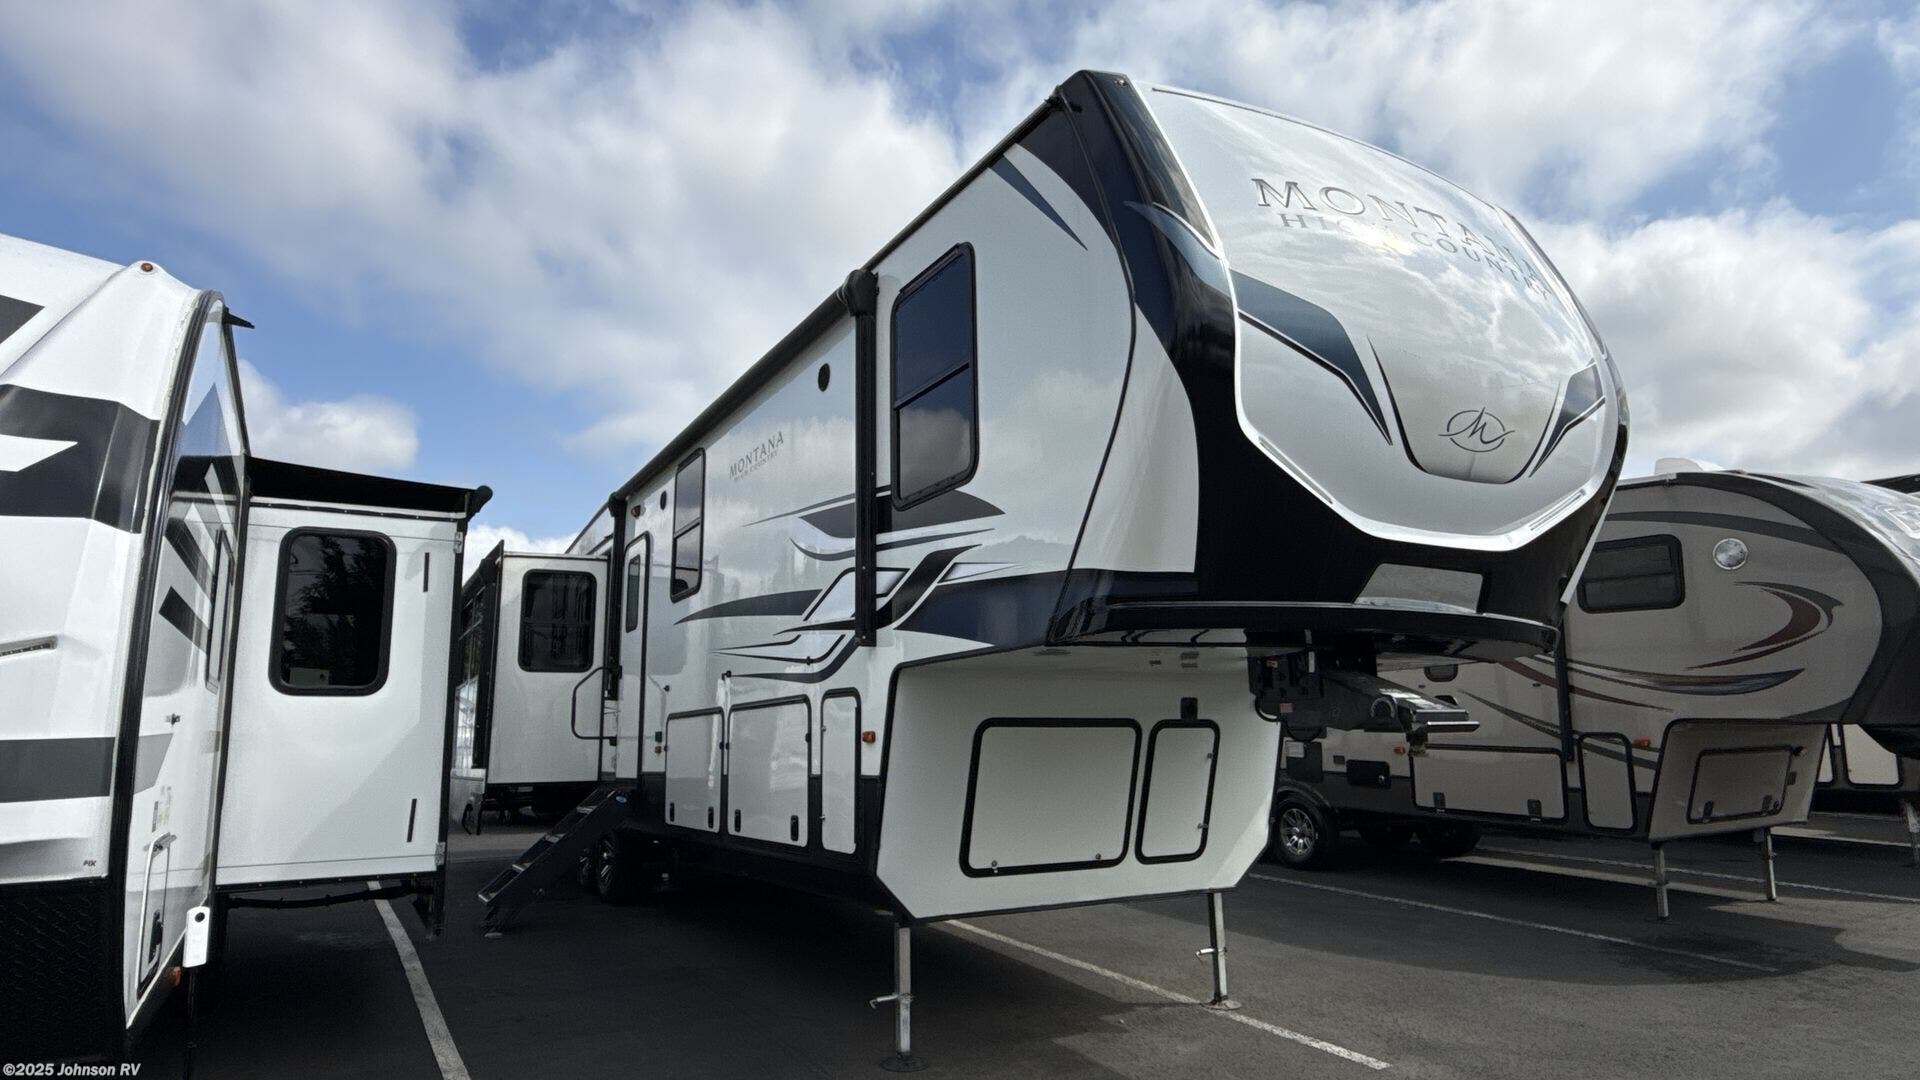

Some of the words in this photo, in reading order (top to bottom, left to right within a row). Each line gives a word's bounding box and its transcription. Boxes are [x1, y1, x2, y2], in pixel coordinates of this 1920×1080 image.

[1251, 178, 1551, 294] MONTANA
[1411, 231, 1552, 300] COUNTRY
[729, 431, 784, 480] MONTANA
